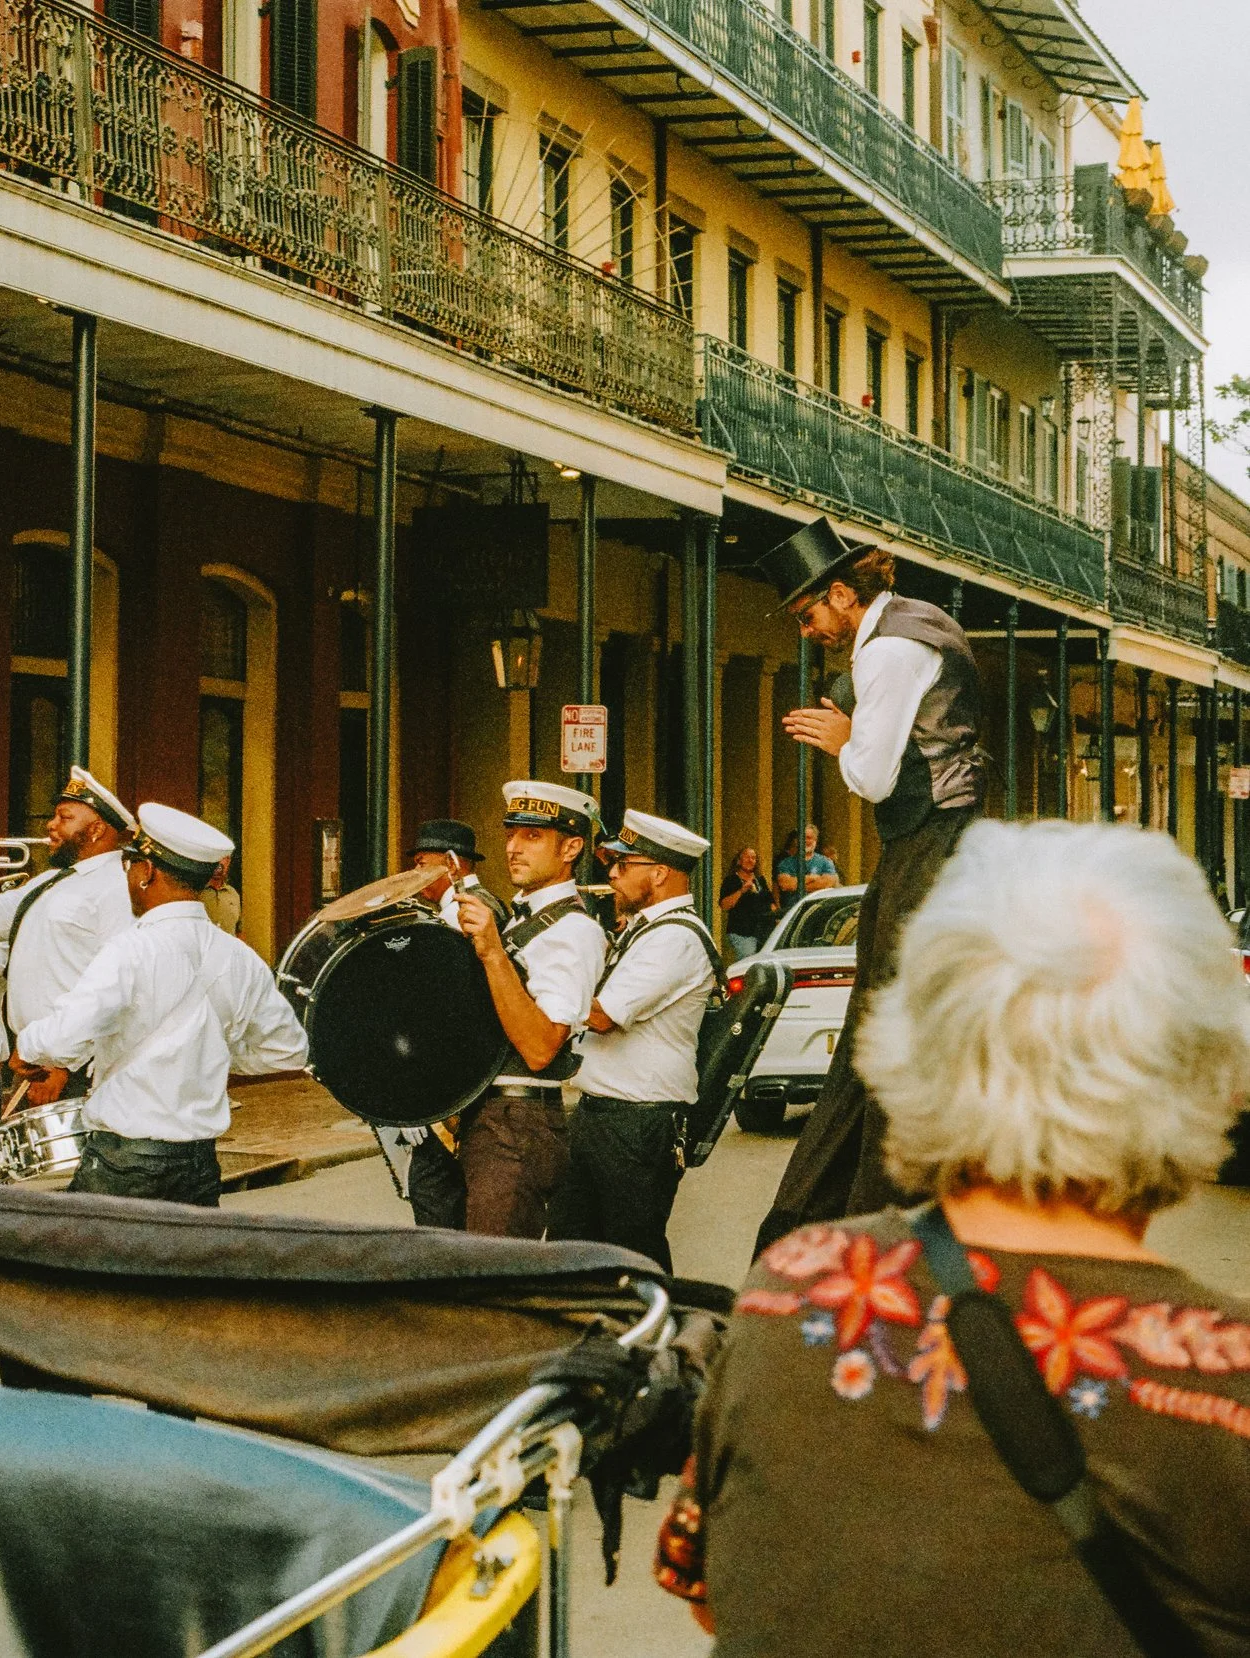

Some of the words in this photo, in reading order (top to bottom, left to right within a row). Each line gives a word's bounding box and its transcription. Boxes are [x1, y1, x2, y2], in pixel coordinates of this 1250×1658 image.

[564, 709, 579, 721] NO
[573, 727, 595, 739] FIRE
[571, 742, 596, 753] LANE
[527, 799, 556, 815] FUN
